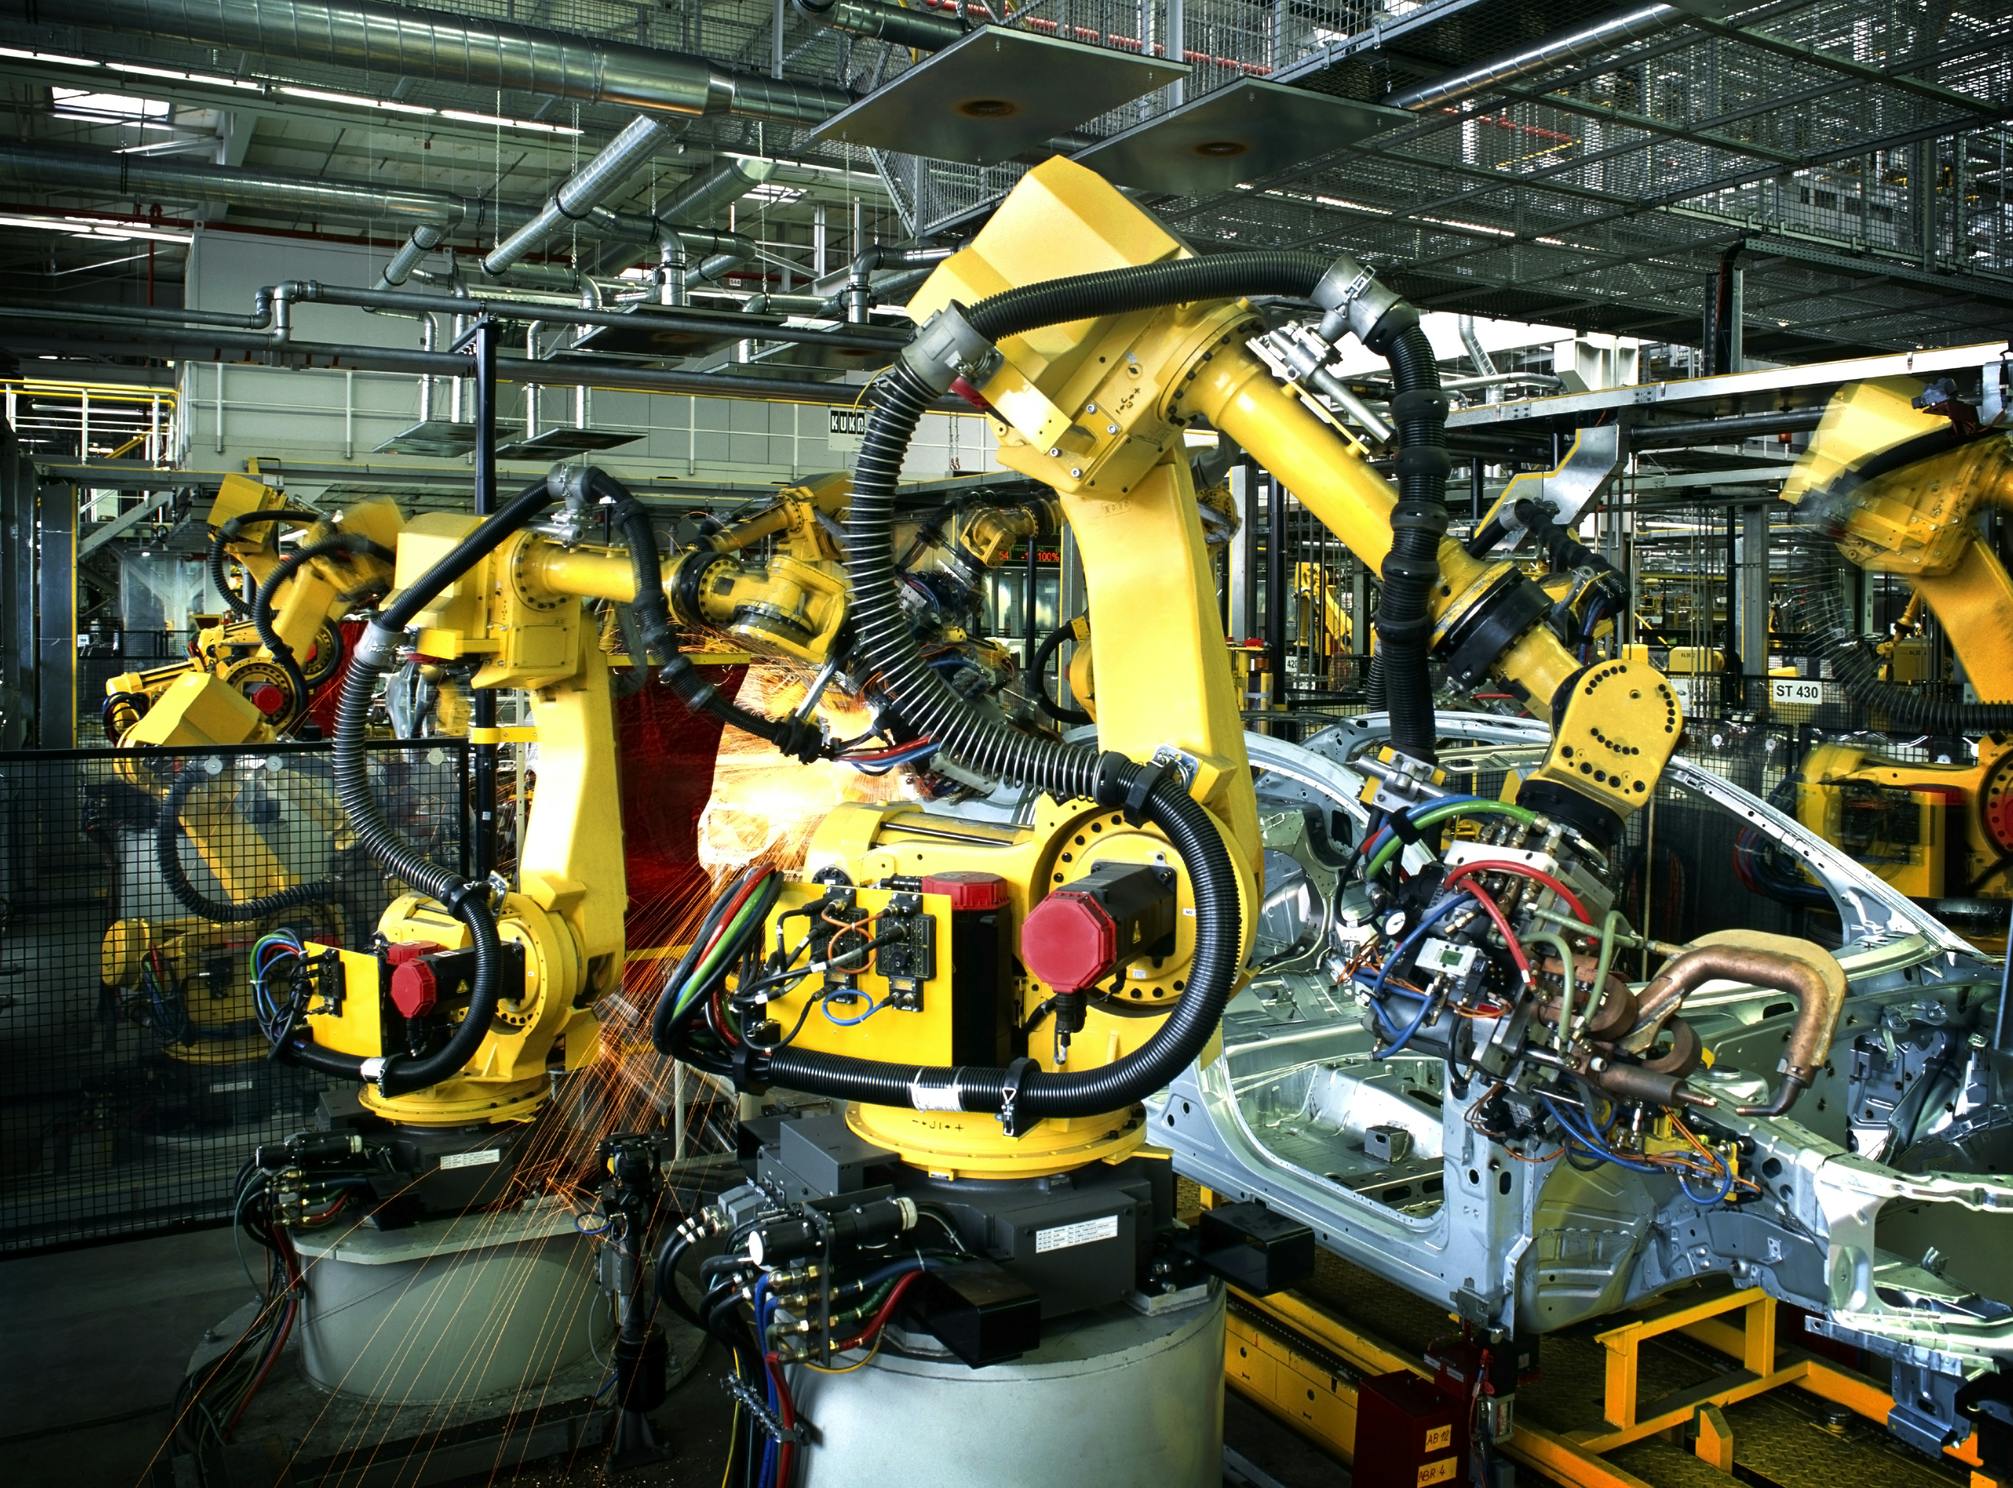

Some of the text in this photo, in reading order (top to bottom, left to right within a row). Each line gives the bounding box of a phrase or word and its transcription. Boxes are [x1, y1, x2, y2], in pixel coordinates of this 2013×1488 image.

[831, 415, 864, 432] KUKA
[1038, 551, 1060, 561] 100%
[1776, 684, 1818, 699] ST 430
[1426, 1432, 1439, 1446] AB
[1439, 1464, 1446, 1477] 4
